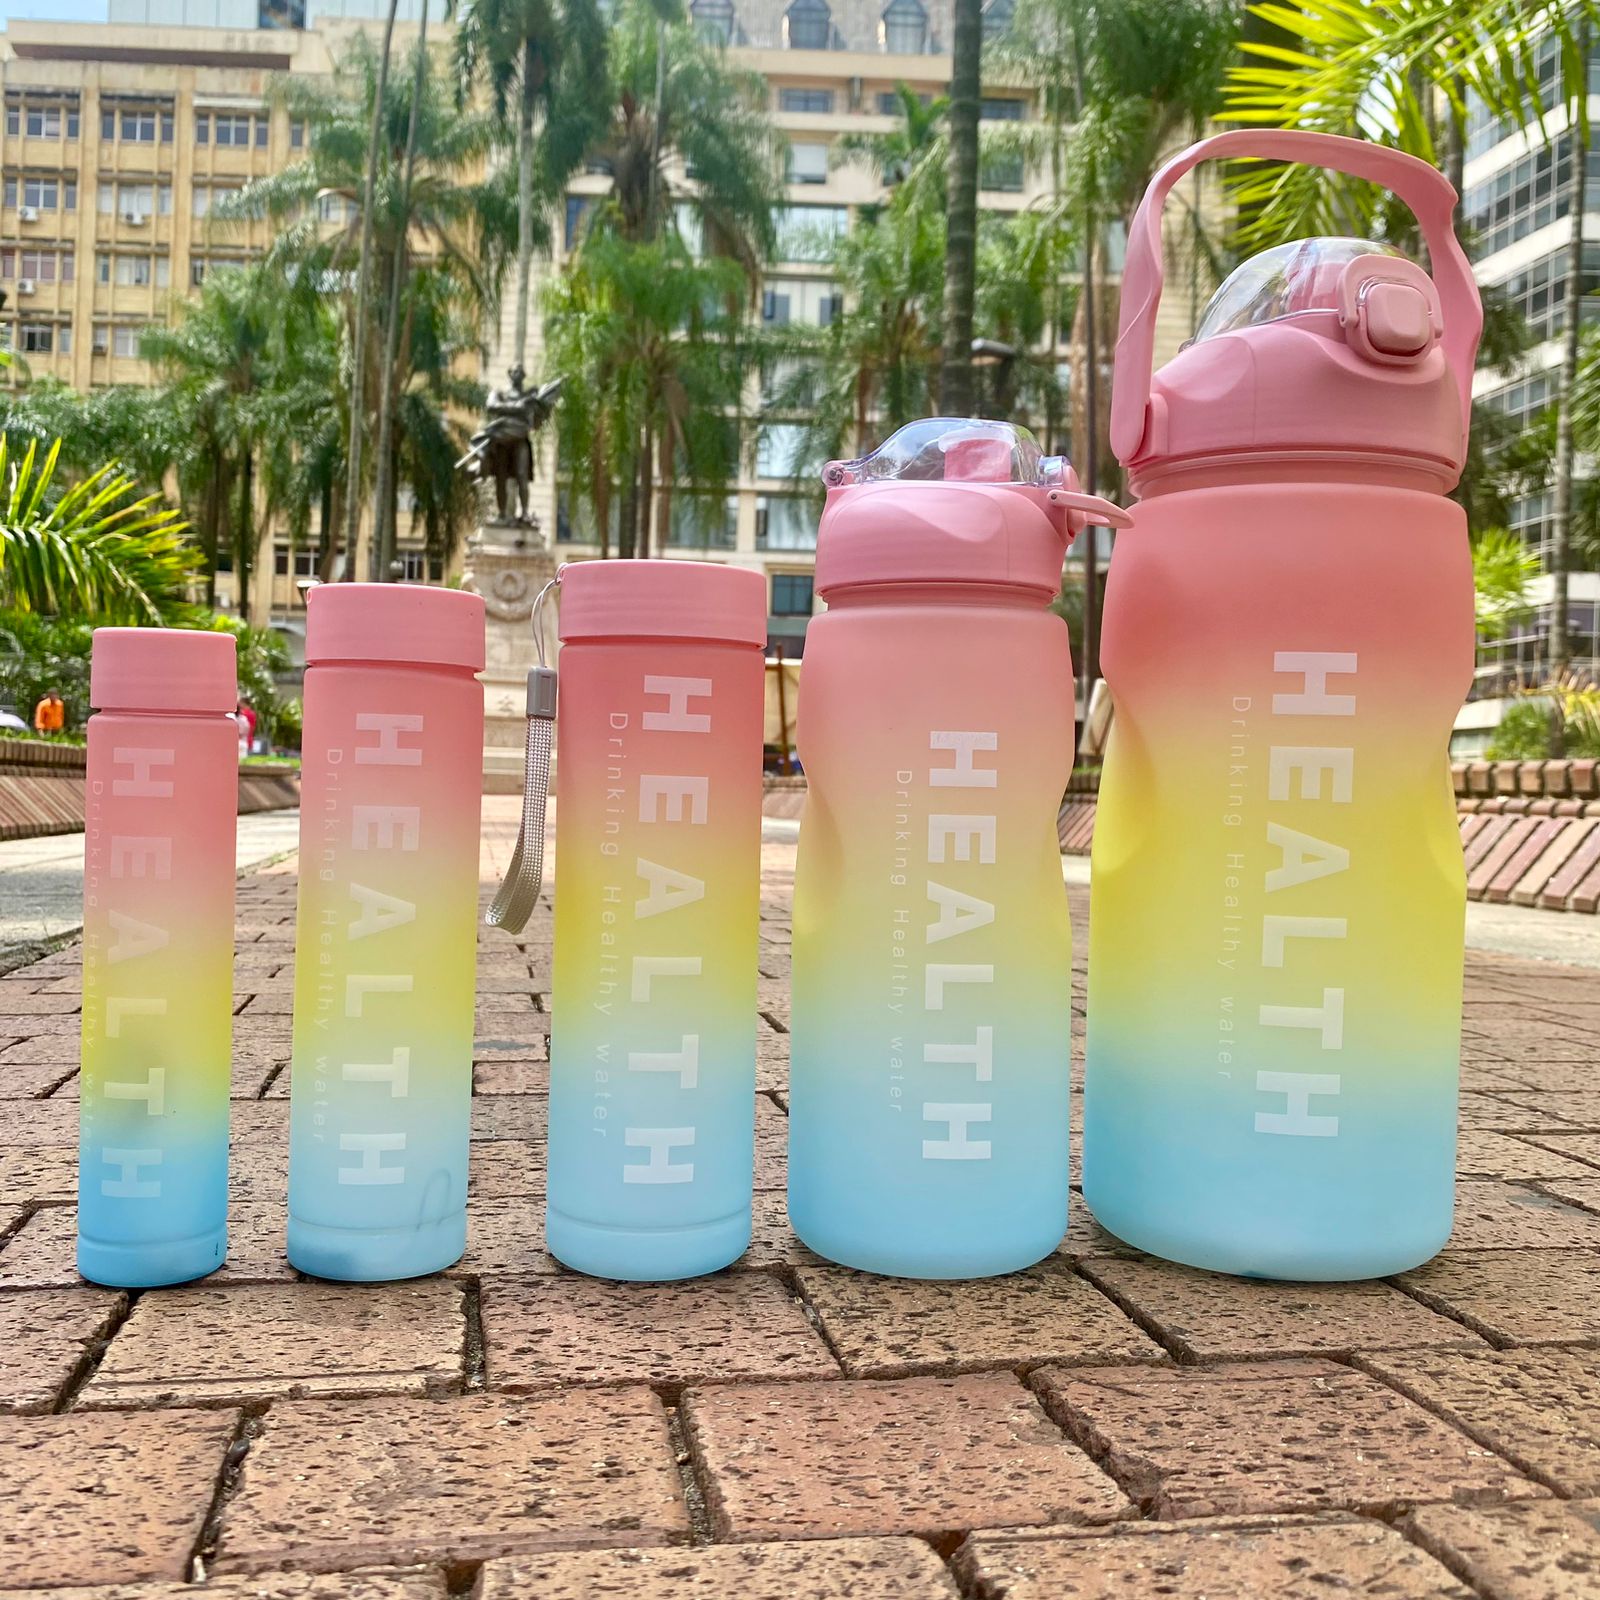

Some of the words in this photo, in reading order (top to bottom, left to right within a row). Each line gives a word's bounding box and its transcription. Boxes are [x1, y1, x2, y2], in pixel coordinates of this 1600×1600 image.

[320, 749, 343, 881] Drinking
[601, 712, 629, 856] Drinking
[1223, 696, 1251, 826] Drinking
[890, 770, 912, 885] Drinking
[338, 713, 424, 1185] HEALTH
[594, 886, 621, 1015] Healthy
[623, 674, 713, 1184] HEALTH
[922, 731, 998, 1159] HEALTH
[1217, 853, 1244, 969] Healthy
[1254, 651, 1358, 1137] HEALTH
[101, 747, 175, 1197] HEALTH
[314, 910, 336, 1030] Healthy
[888, 910, 909, 1015] Healthy
[313, 1056, 328, 1143] water
[593, 1043, 612, 1136] water
[889, 1037, 905, 1112] water
[1218, 997, 1235, 1079] water
